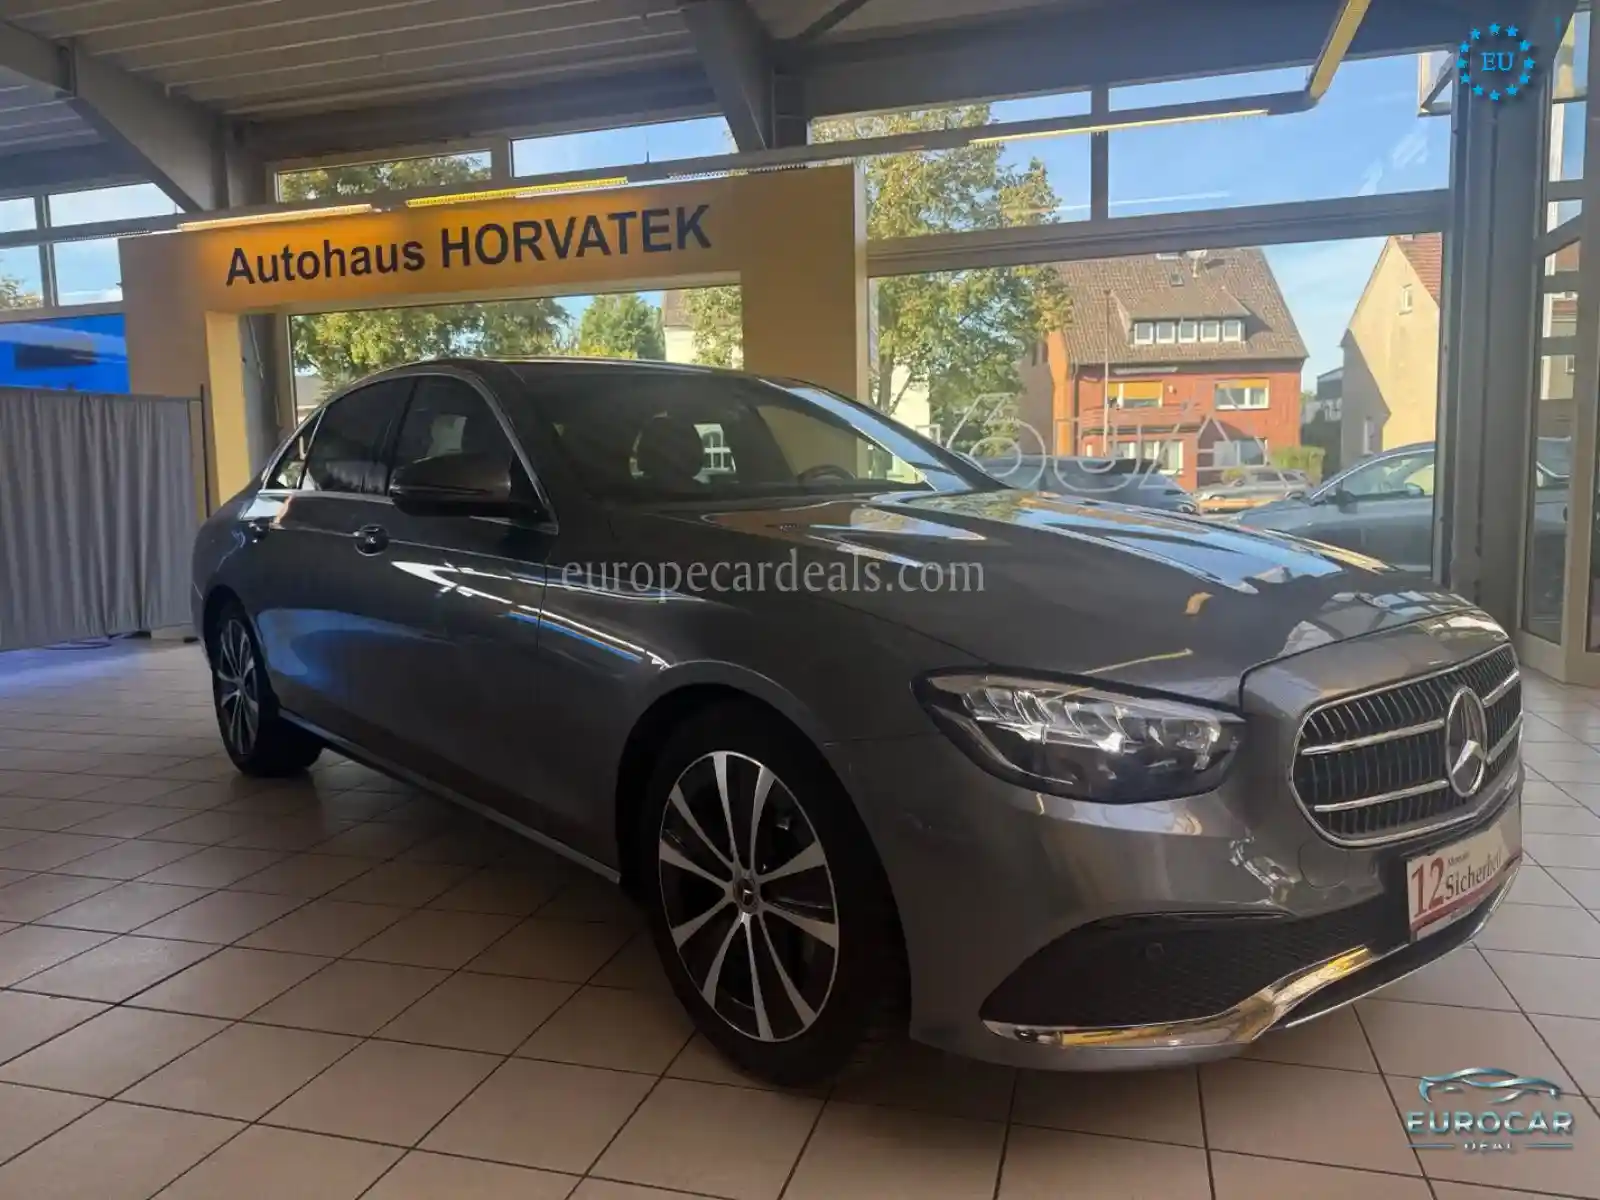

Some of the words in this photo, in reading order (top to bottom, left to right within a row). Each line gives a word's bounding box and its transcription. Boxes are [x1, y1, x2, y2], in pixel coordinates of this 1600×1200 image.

[226, 239, 425, 287] Autohaus
[441, 203, 713, 268] HORVATEK
[1411, 856, 1445, 919] 12
